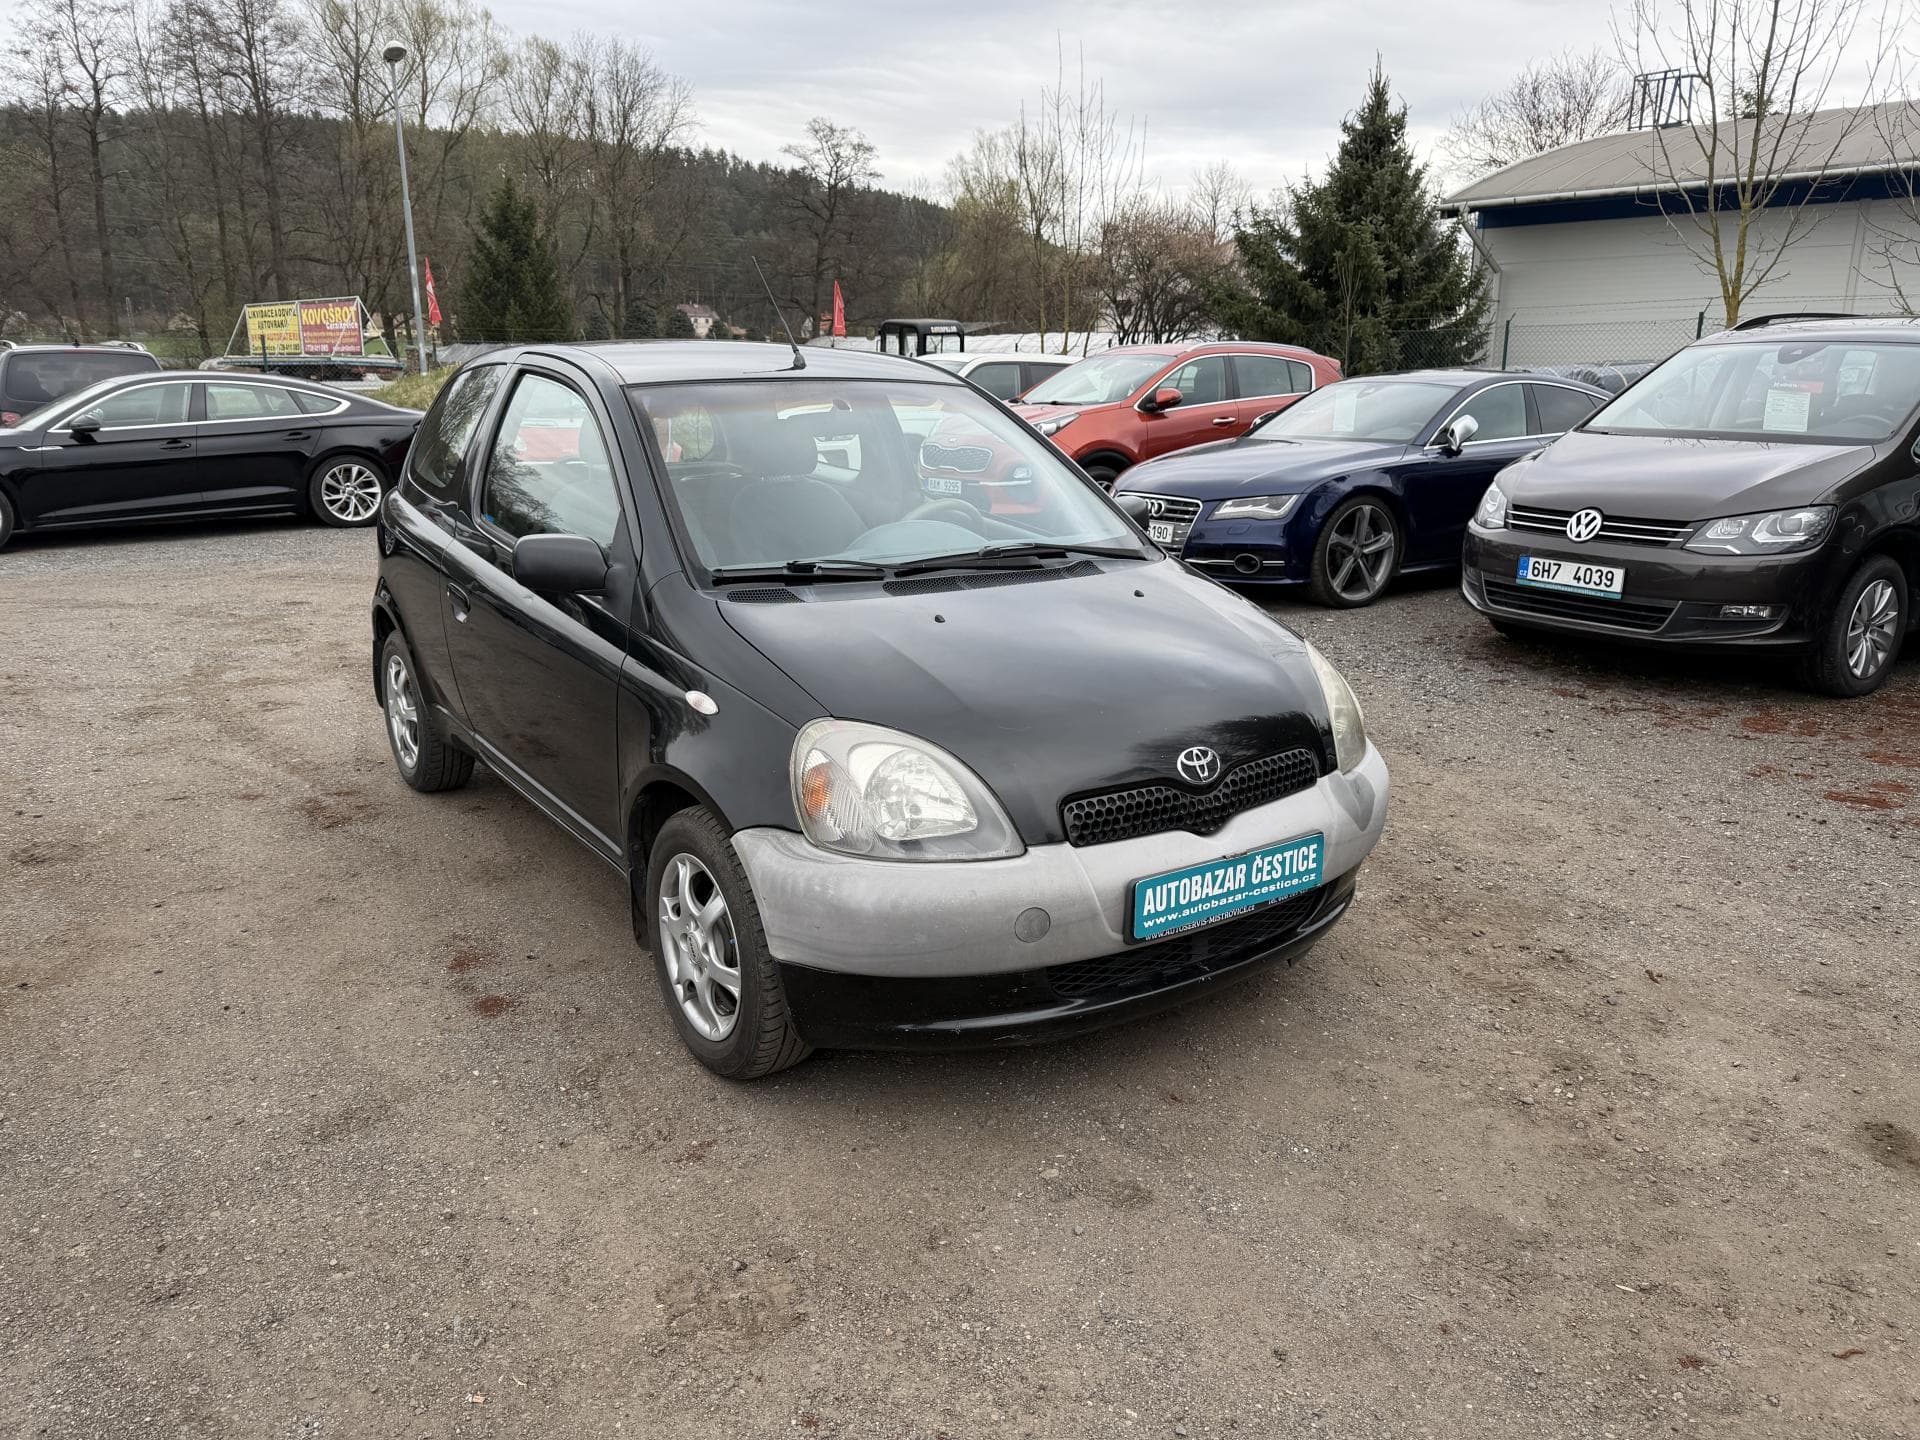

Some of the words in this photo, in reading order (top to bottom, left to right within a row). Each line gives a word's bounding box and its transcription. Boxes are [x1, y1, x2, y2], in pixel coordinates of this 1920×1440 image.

[301, 304, 357, 325] KOVOŠROT
[1531, 560, 1562, 580] 6H7
[1572, 566, 1615, 588] 4039
[1142, 863, 1247, 917] AUTOBAZAR
[1251, 843, 1318, 885] ČESTICE
[1143, 872, 1317, 929] www.autobazar-cestice.cz
